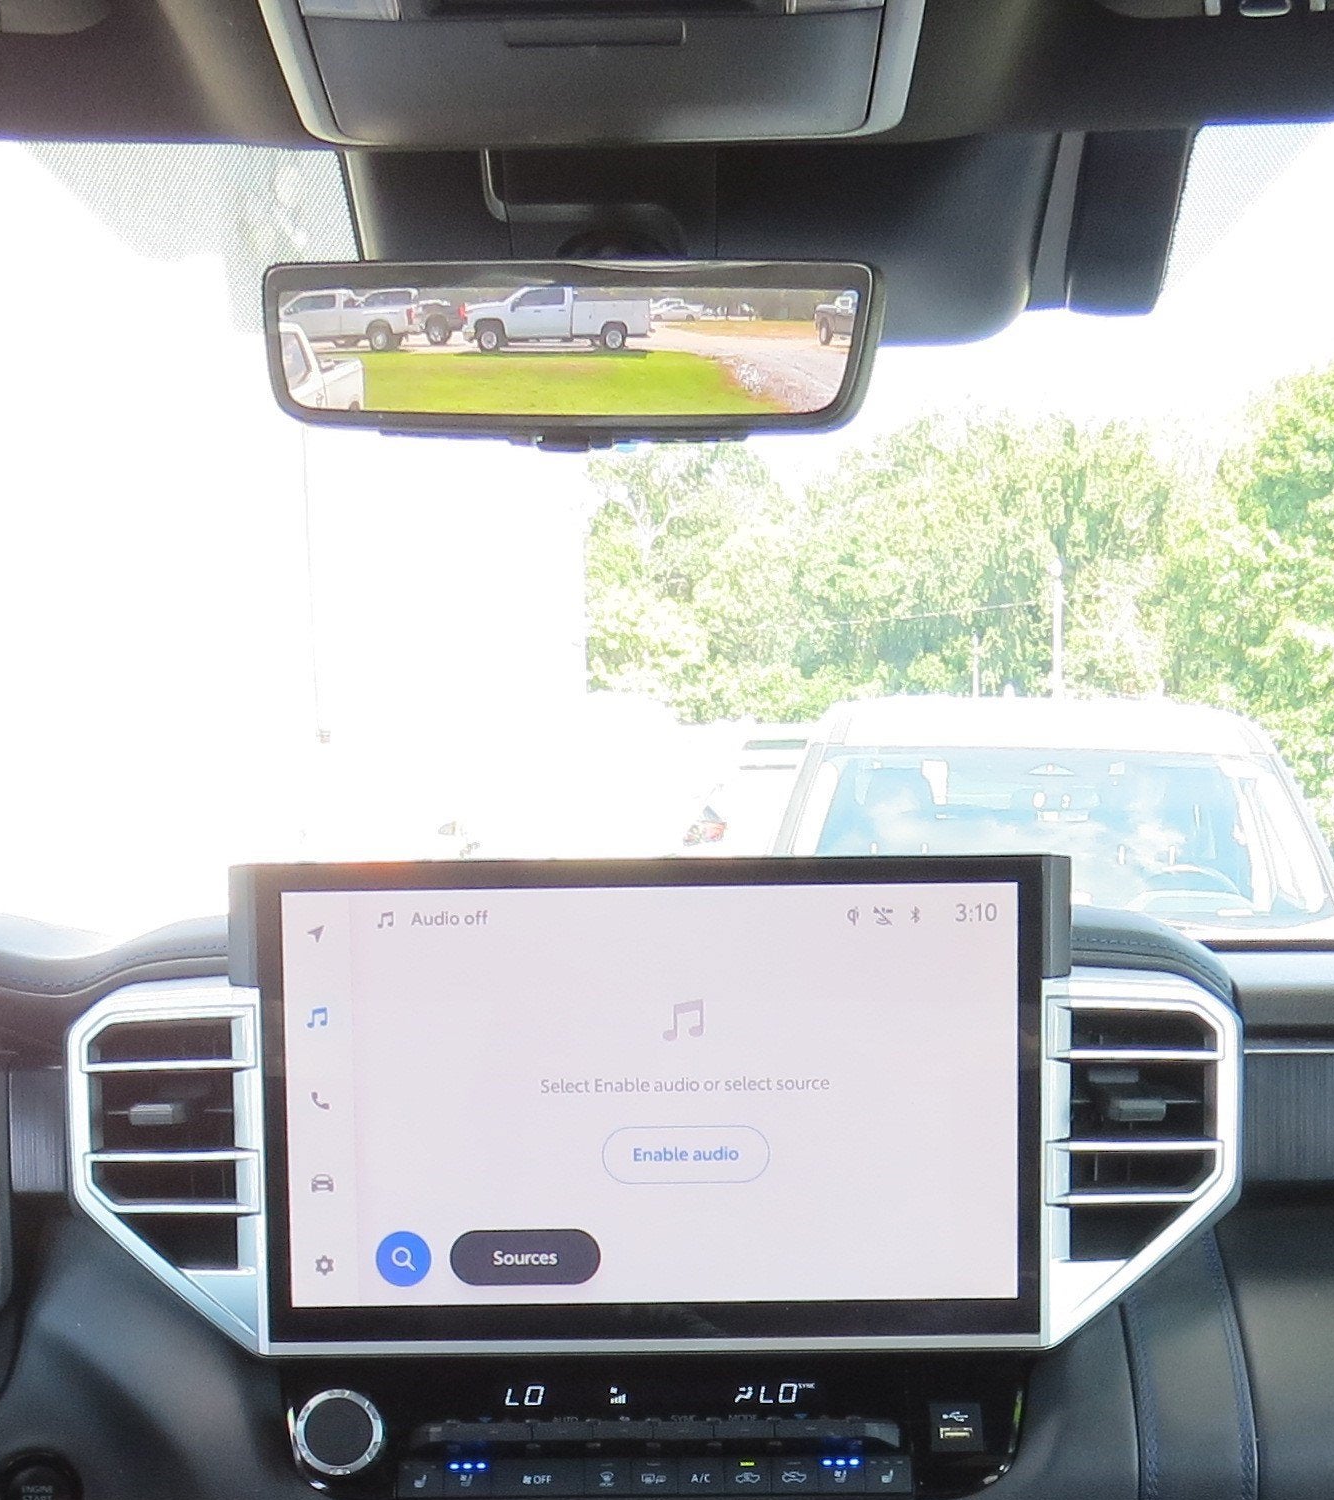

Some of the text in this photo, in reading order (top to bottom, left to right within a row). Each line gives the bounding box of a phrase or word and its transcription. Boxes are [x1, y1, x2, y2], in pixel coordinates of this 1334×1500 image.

[411, 910, 488, 927] Audio off
[955, 903, 998, 922] 3:10
[540, 1076, 830, 1094] Select Enable audio or select source
[633, 1146, 740, 1162] Enable audio
[493, 1251, 558, 1266] Sources
[533, 1474, 553, 1485] OFF
[690, 1473, 711, 1484] A/C
